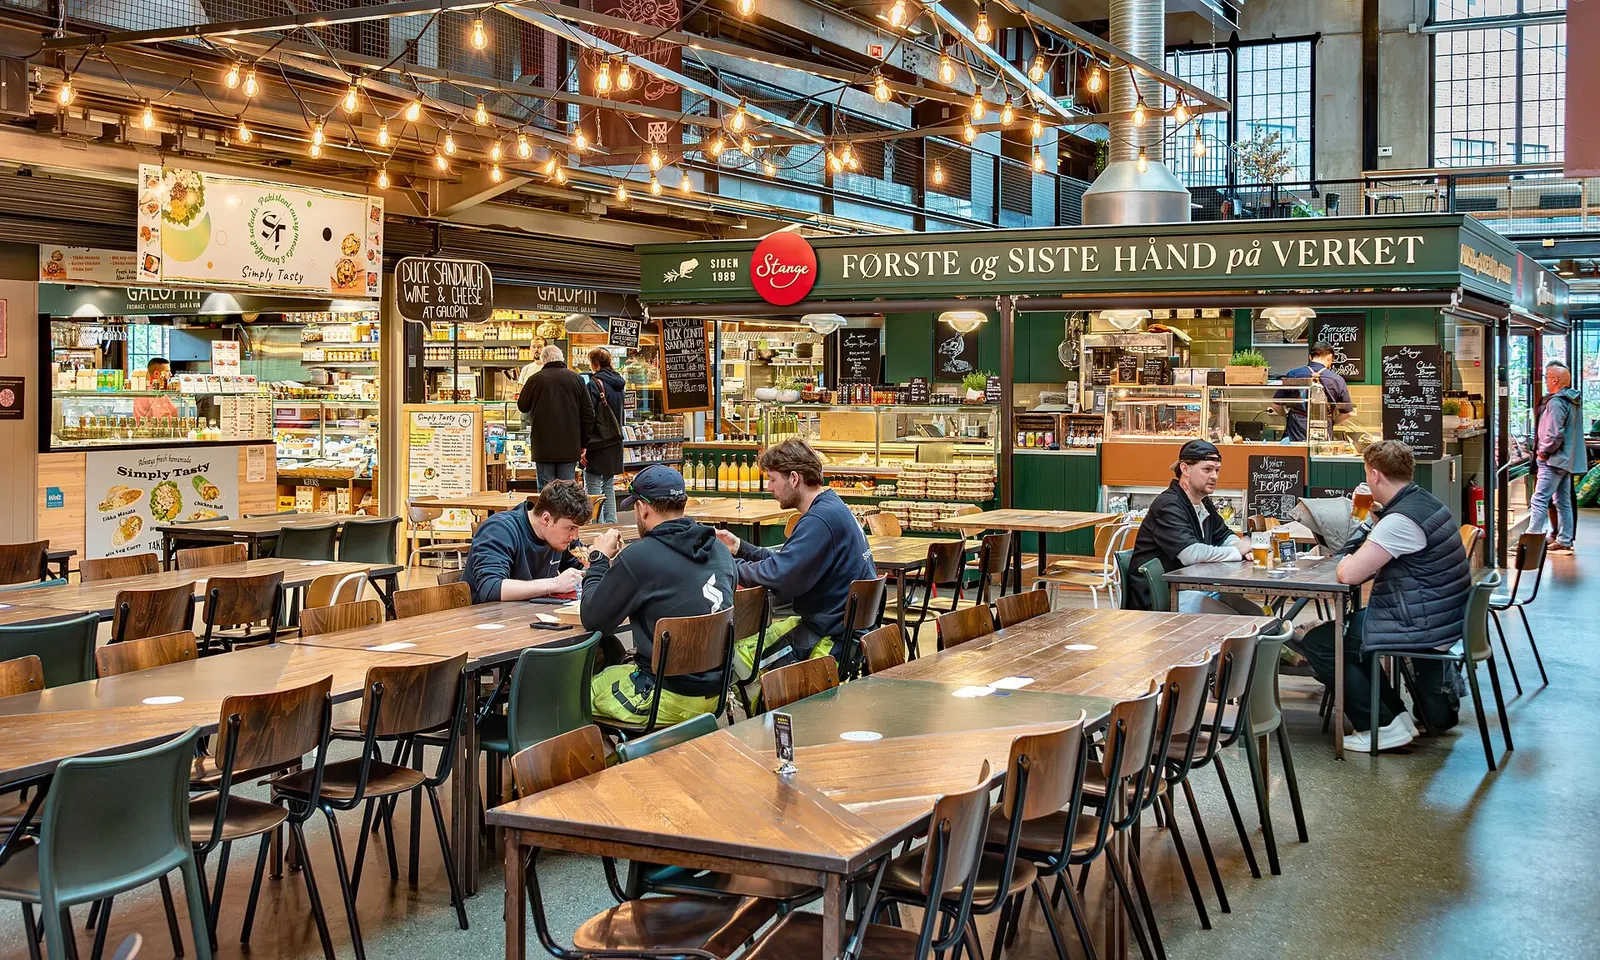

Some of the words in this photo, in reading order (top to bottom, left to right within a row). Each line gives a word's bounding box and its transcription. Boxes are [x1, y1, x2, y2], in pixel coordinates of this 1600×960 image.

[710, 258, 739, 269] SIDEN
[841, 250, 961, 279] FØRSTE
[970, 255, 1000, 281] og
[1007, 246, 1100, 274] SISTE
[1113, 237, 1217, 272] HÅND
[1225, 239, 1262, 275] på
[1272, 235, 1424, 268] VERKET
[241, 265, 273, 282] Simply
[278, 269, 304, 284] Tasty
[402, 261, 430, 284] DUCK
[433, 262, 483, 288] SANDWICH
[712, 271, 736, 282] 1989
[756, 253, 809, 289] Stange
[403, 284, 430, 303] WINE
[437, 286, 446, 303] &
[451, 286, 483, 305] CHEESE
[422, 306, 435, 319] AT
[436, 305, 468, 319] GALOPIN
[664, 328, 682, 341] DUCK
[683, 327, 704, 340] CONFIT
[1317, 332, 1357, 343] CHICKEN
[665, 339, 695, 351] SANDWICH
[417, 413, 437, 422] Simply
[438, 413, 456, 422] Tasty
[138, 458, 156, 467] Always
[155, 454, 168, 466] fresh
[168, 455, 192, 464] homemade
[116, 466, 171, 480] Simply
[172, 462, 210, 477] Tasty
[1256, 480, 1293, 493] BOARD
[193, 501, 213, 509] Chicken
[102, 514, 117, 522] Tikka
[117, 508, 136, 517] Masala
[126, 543, 141, 551] Curry
